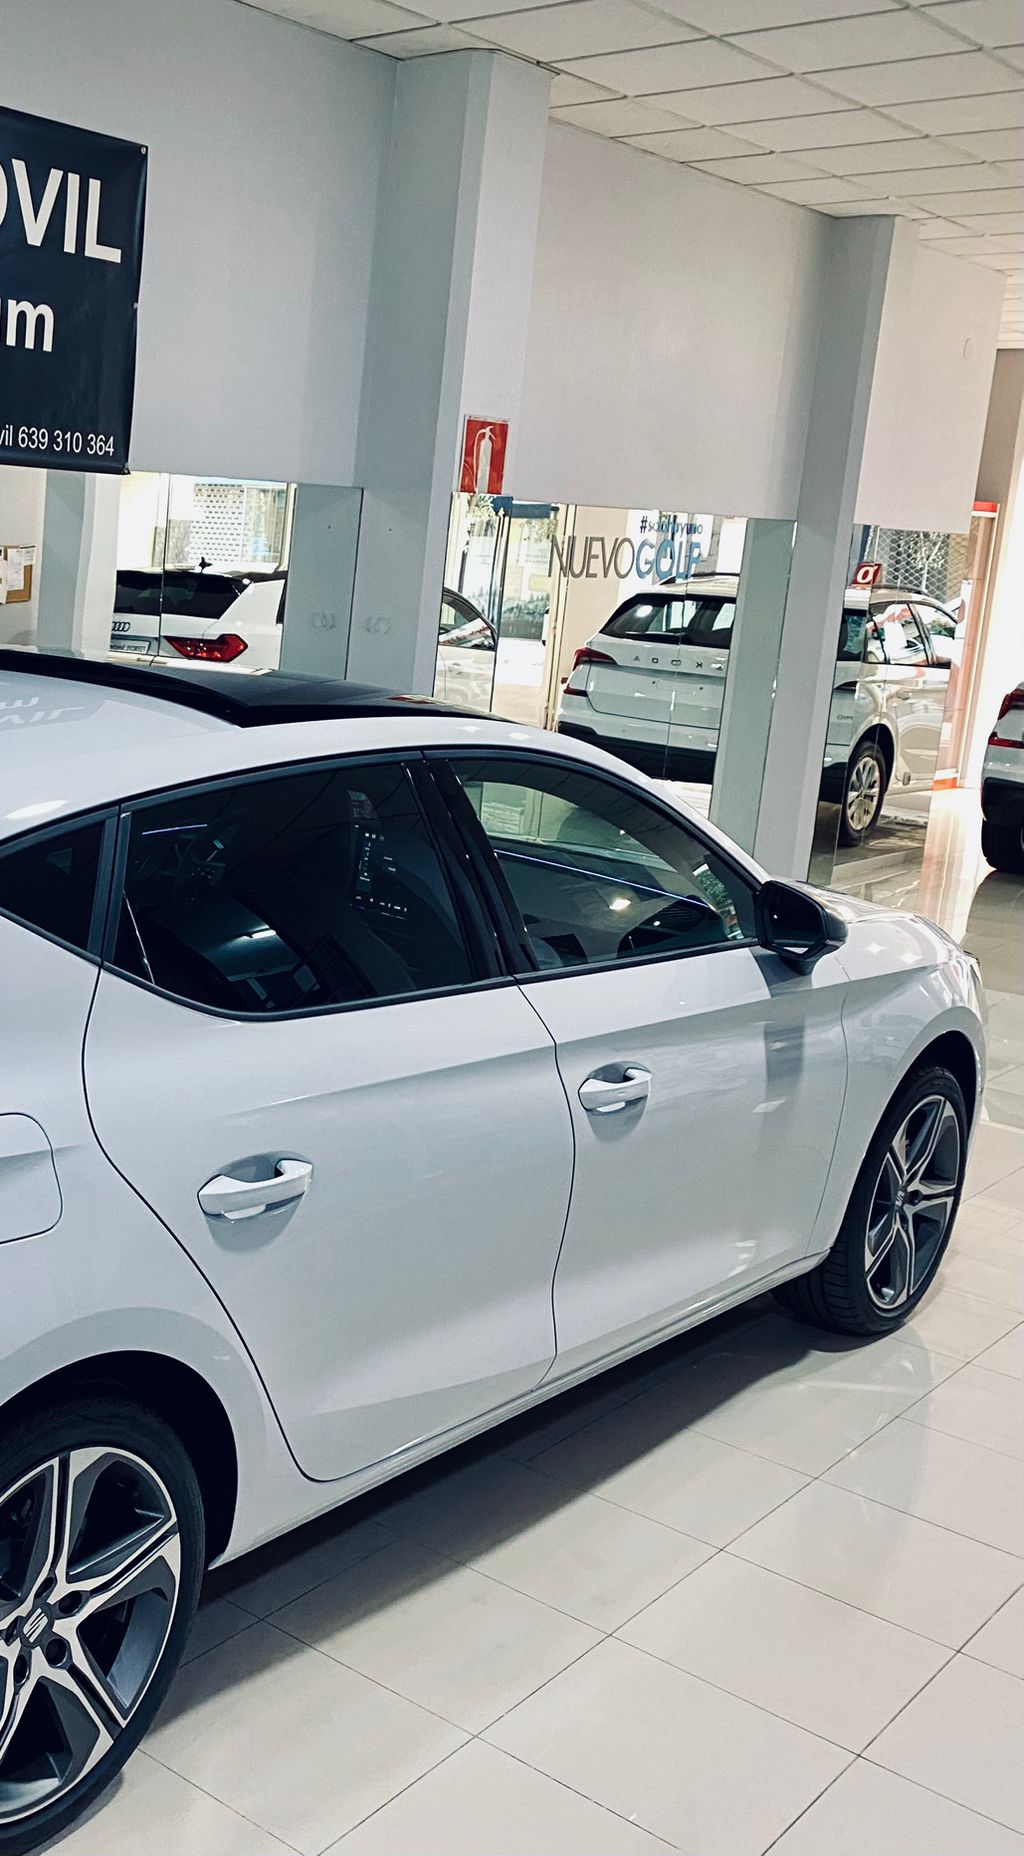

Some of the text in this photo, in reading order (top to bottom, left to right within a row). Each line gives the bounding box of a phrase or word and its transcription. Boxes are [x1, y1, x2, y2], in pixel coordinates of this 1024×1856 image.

[18, 426, 49, 450] 639
[52, 429, 83, 454] 310
[86, 433, 115, 457] 364
[547, 534, 702, 581] NUEVO GOLF
